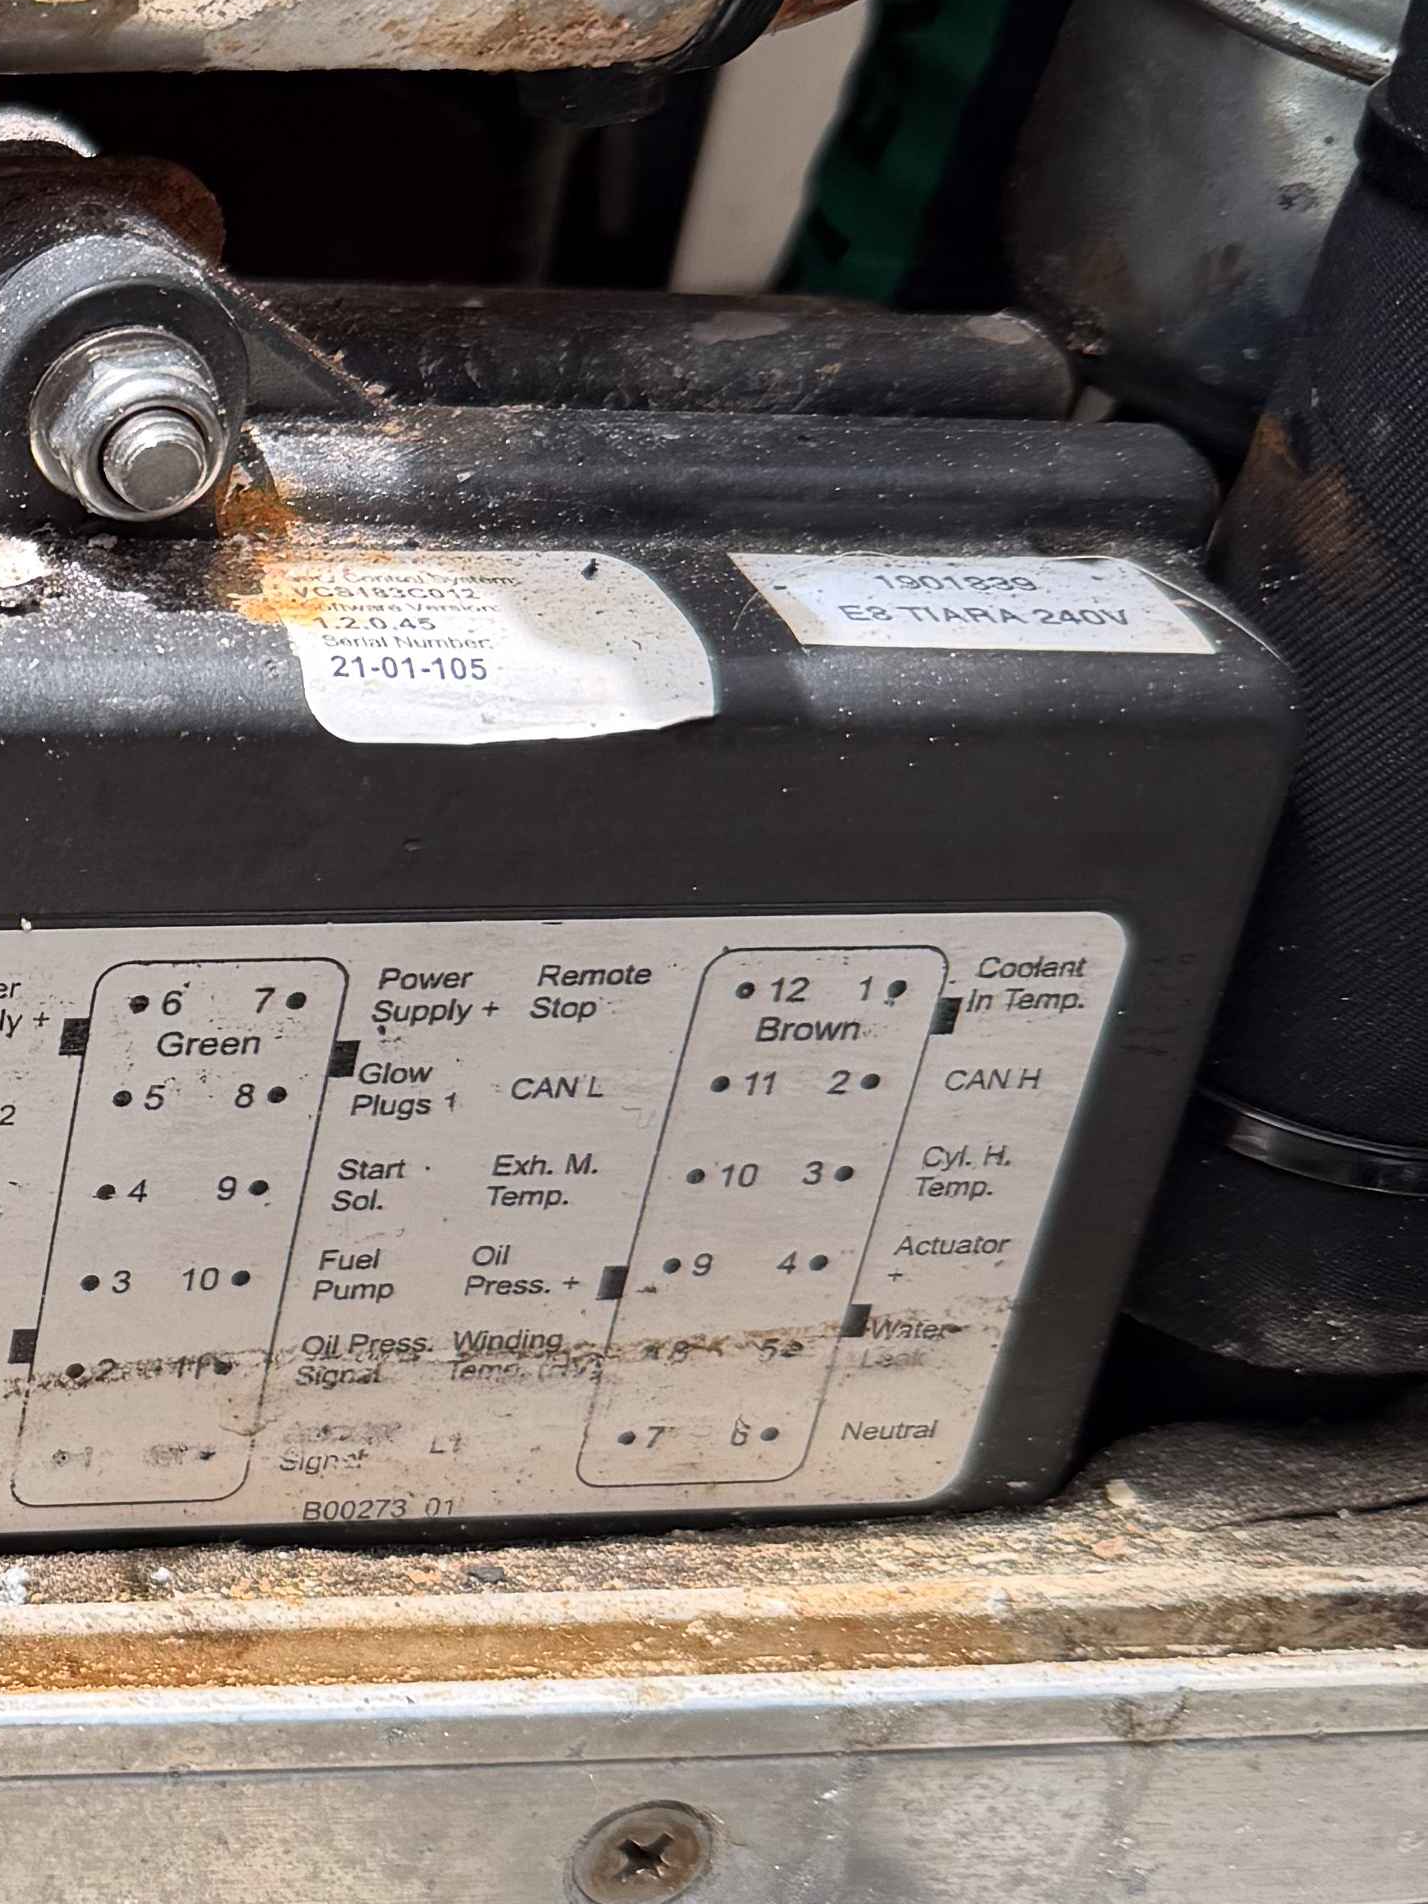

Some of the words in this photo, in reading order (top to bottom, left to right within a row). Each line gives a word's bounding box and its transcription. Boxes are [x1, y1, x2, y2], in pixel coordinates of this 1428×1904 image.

[875, 575, 1038, 593] 1901839
[312, 617, 436, 632] 1.2.0.45
[897, 606, 1029, 625] TIARA
[1032, 608, 1130, 627] 240V
[322, 634, 389, 649] Serial
[331, 655, 488, 681] 21-01-105
[377, 967, 474, 990] Power
[537, 964, 653, 987] Remote
[978, 956, 1089, 979] Coolant
[770, 977, 811, 1003] 12
[859, 976, 873, 1001] 1
[161, 990, 182, 1016] 6
[255, 988, 275, 1014] 7
[371, 998, 472, 1026] Supply
[529, 997, 597, 1023] Stop
[1004, 989, 1086, 1014] Temp.
[754, 1017, 860, 1043] Brown
[156, 1032, 261, 1058] Green
[359, 1062, 433, 1084] Glow
[745, 1071, 777, 1095] 11
[827, 1070, 850, 1095] 2
[945, 1068, 1012, 1091] CAN
[1017, 1067, 1043, 1090] H
[144, 1085, 166, 1110] 5
[234, 1084, 255, 1108] 8
[511, 1077, 579, 1100] CAN
[350, 1094, 432, 1120] Plugs
[337, 1158, 407, 1180] Start
[492, 1154, 553, 1176] Exh.
[565, 1153, 599, 1175] M.
[923, 1146, 972, 1171] Cyl.
[982, 1145, 1011, 1166] H.
[721, 1163, 759, 1187] 10
[802, 1161, 823, 1186] 3
[127, 1179, 148, 1203] 4
[217, 1176, 238, 1201] 9
[486, 1186, 569, 1210] Temp.
[914, 1177, 993, 1200] Temp.
[331, 1190, 383, 1212] Sol.
[472, 1245, 511, 1266] Oil
[893, 1235, 1013, 1256] Actuator
[318, 1248, 381, 1270] Fuel
[692, 1253, 713, 1277] 9
[776, 1252, 798, 1275] 4
[111, 1270, 132, 1293] 3
[182, 1268, 220, 1291] 10
[312, 1279, 394, 1303] Pump
[464, 1275, 550, 1296] Press.
[871, 1318, 946, 1340] Water
[301, 1334, 339, 1356] Oil
[347, 1333, 434, 1354] Press.
[453, 1330, 564, 1353] Winding
[647, 1427, 667, 1449] 7
[841, 1419, 939, 1442] Neutral
[303, 1499, 407, 1520] B00273
